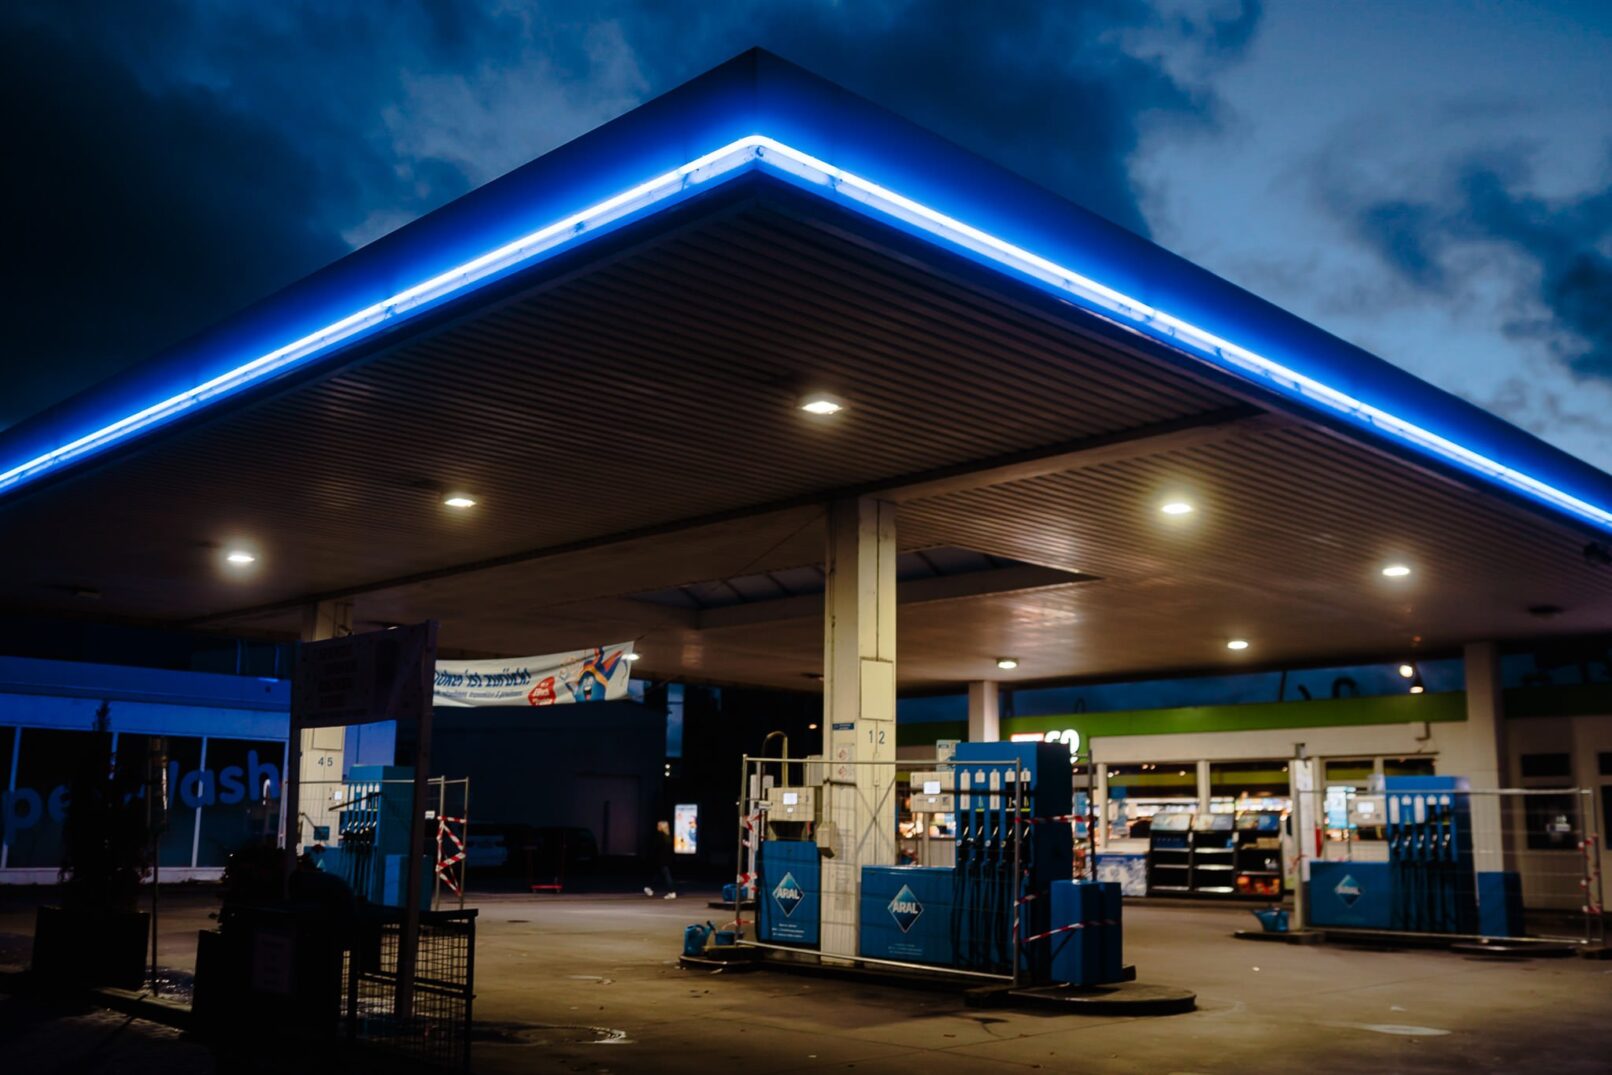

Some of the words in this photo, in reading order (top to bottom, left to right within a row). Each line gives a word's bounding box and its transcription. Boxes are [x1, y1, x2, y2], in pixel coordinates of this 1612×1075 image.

[869, 730, 873, 744] 1
[879, 730, 885, 745] 2
[318, 757, 324, 766] 4
[327, 757, 333, 767] 5
[893, 901, 919, 914] ARAL
